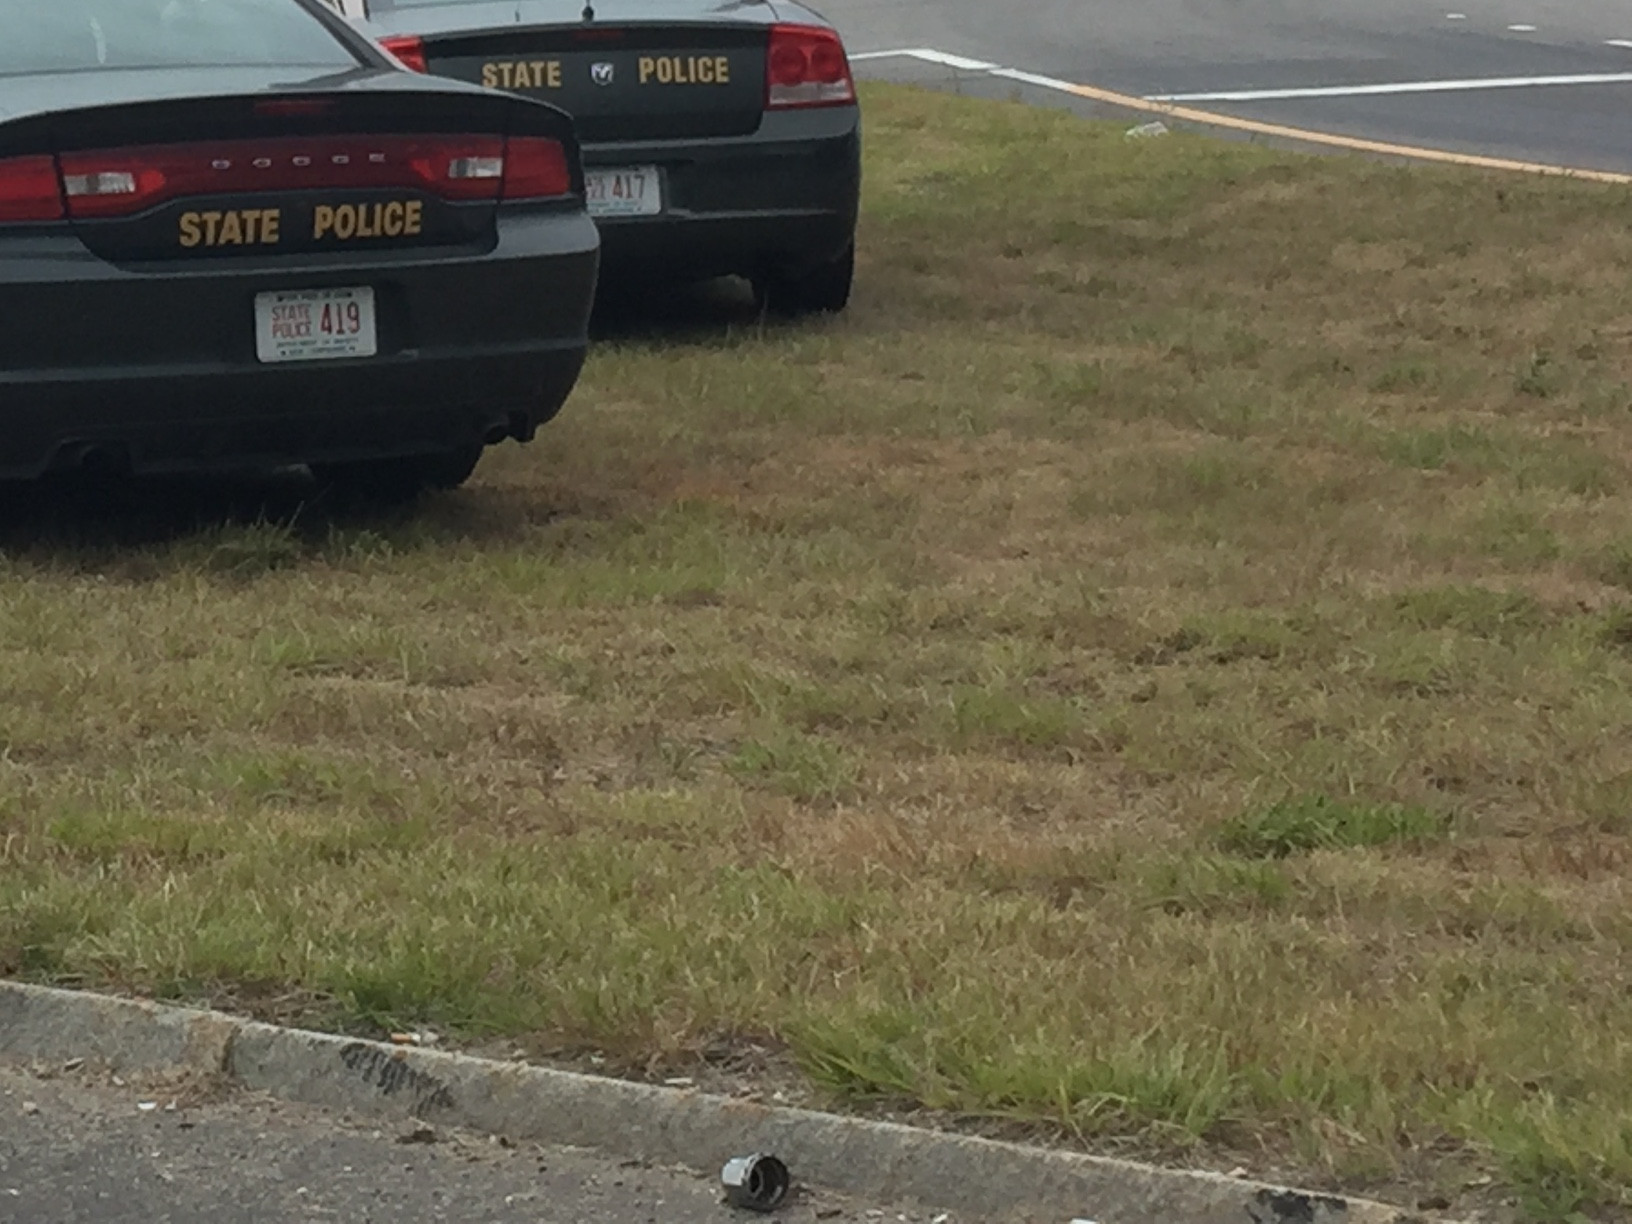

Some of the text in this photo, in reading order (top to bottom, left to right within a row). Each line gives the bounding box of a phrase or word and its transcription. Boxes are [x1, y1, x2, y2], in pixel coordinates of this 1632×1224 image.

[482, 57, 730, 89] STATE POLICE
[612, 174, 646, 199] 417
[179, 201, 422, 247] STATE POLICE
[272, 303, 311, 321] STATE
[321, 301, 361, 335] 419
[272, 321, 312, 339] POLICE
